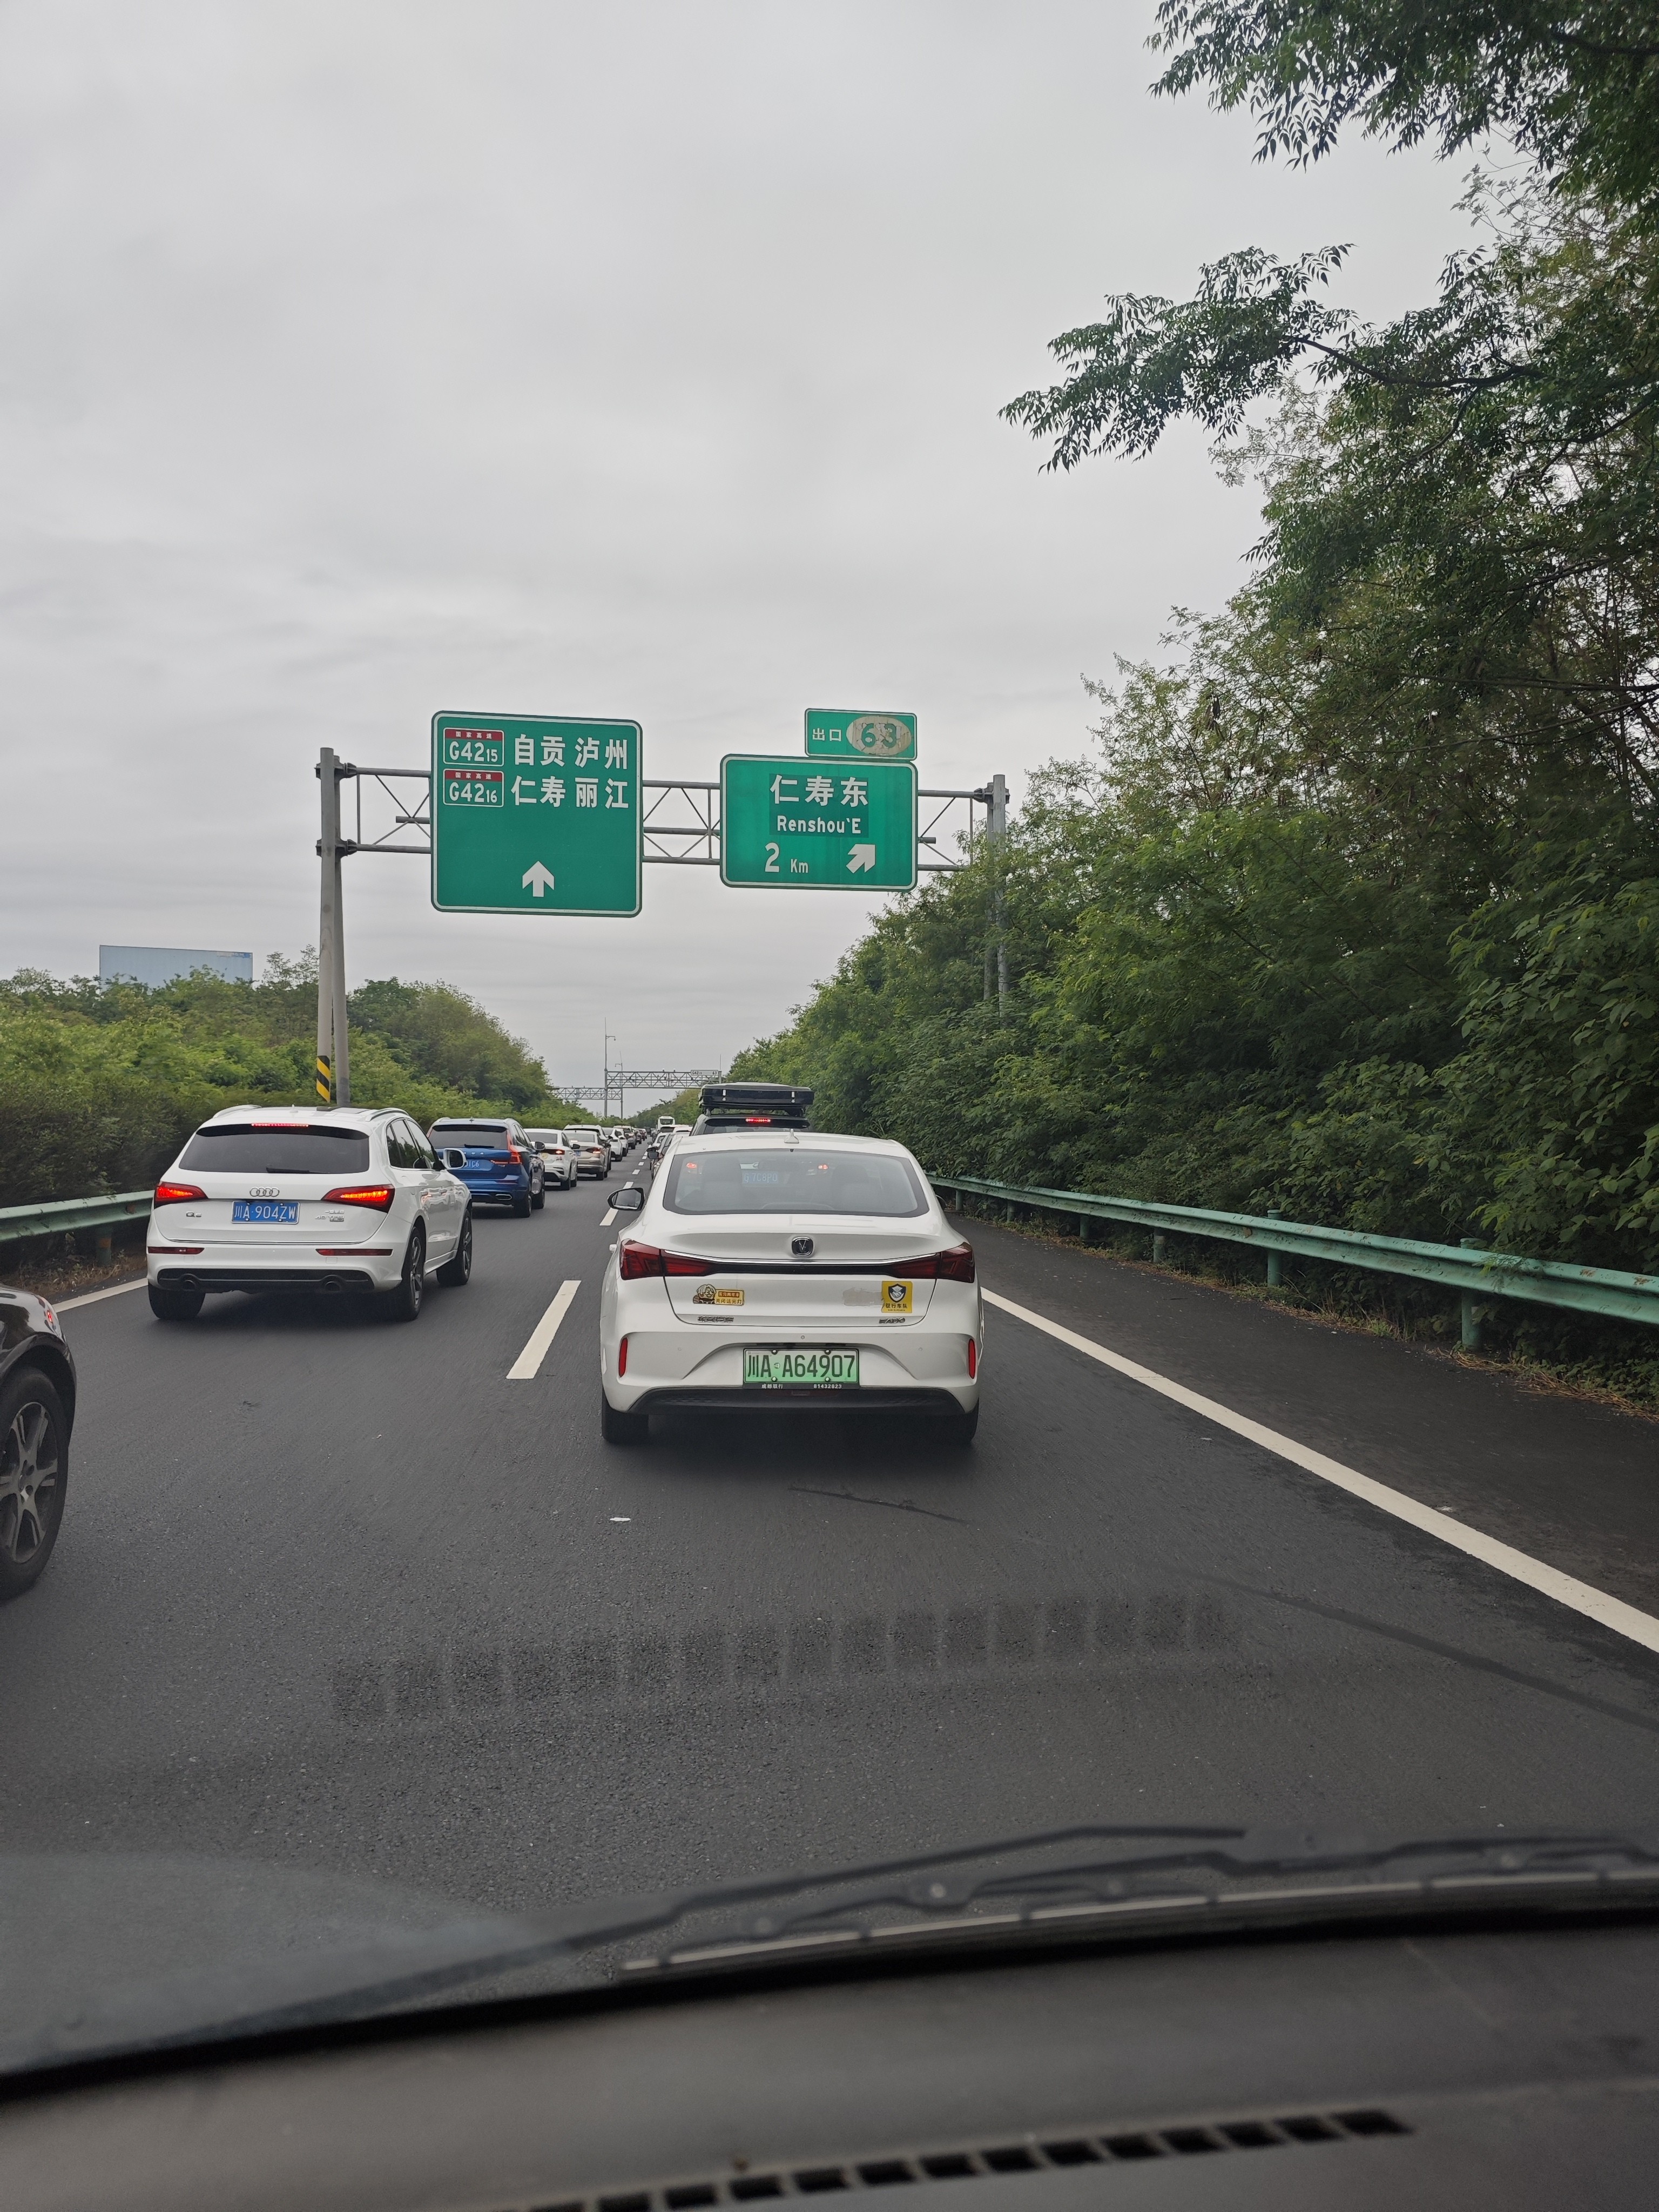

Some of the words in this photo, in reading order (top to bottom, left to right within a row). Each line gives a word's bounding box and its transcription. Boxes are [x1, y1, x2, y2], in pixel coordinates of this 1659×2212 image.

[812, 728, 841, 741] 出口
[861, 723, 896, 748] 63
[449, 741, 497, 762] G4215
[514, 734, 565, 767] 自贡
[575, 737, 628, 770] 泸州
[449, 782, 497, 802] G4216
[511, 775, 566, 807] 仁寿
[575, 777, 629, 809] 丽江
[770, 774, 868, 807] 仁寿东
[765, 842, 779, 873] 2
[791, 859, 808, 873] Km
